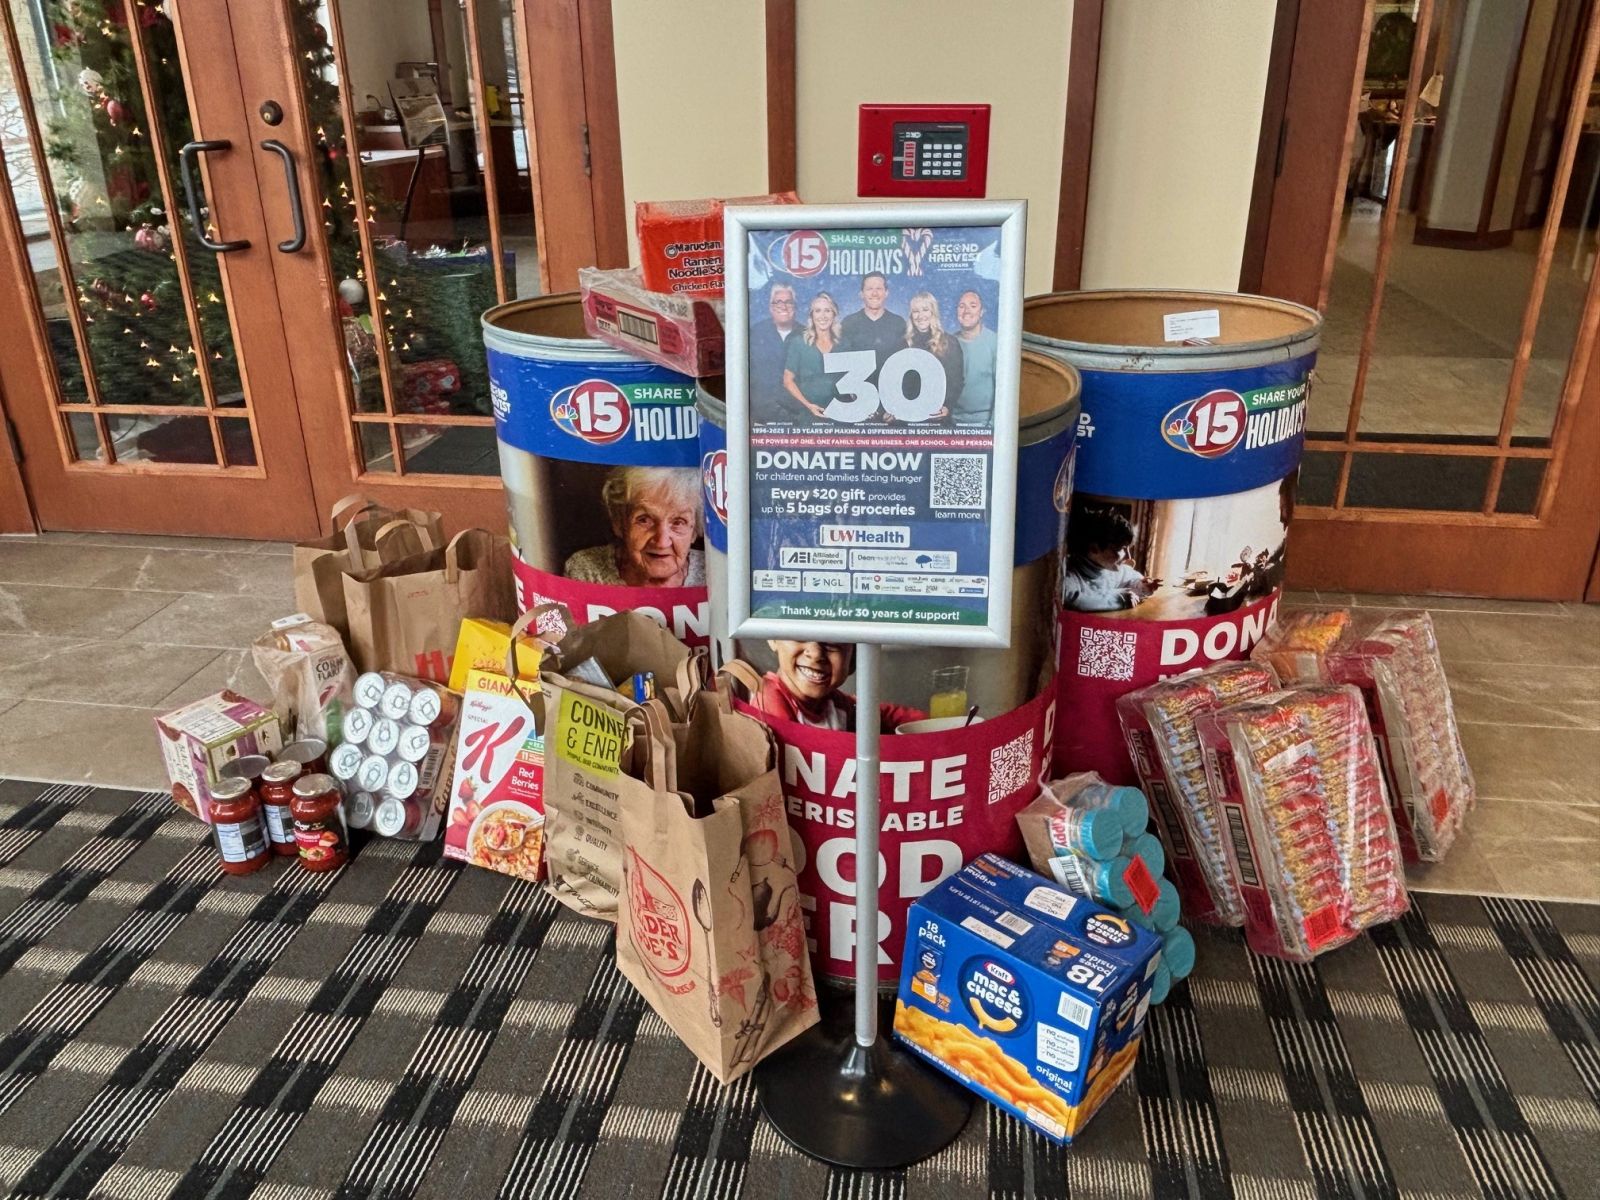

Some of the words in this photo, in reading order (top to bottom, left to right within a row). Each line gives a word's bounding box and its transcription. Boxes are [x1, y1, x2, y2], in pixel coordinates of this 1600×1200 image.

[676, 241, 721, 252] Maruchan
[831, 234, 864, 244] SHARE
[867, 235, 898, 245] YOUR
[932, 244, 979, 254] SECOND
[684, 256, 721, 267] Ramen
[788, 237, 822, 269] 15
[830, 248, 903, 276] HOLIDAYS
[928, 253, 980, 263] HARVEST
[668, 266, 709, 278] Noodle
[672, 282, 708, 292] Chicken
[634, 388, 682, 400] SHARE
[823, 348, 947, 423] 30
[1252, 390, 1286, 405] SHARE
[1287, 382, 1306, 400] YOUR
[576, 391, 623, 432] 15
[634, 406, 699, 442] HOLID
[1194, 402, 1240, 446] 15
[756, 451, 855, 470] DONATE
[861, 452, 923, 470] NOW
[756, 472, 767, 480] for
[770, 472, 804, 481] children
[807, 473, 824, 481] and
[826, 473, 858, 482] families
[861, 474, 889, 484] facing
[890, 474, 922, 484] hunger
[771, 488, 809, 501] Every
[812, 488, 837, 500] $20
[841, 489, 866, 502] gift
[868, 493, 906, 502] provides
[776, 505, 784, 513] to
[786, 502, 795, 513] 5
[798, 502, 831, 516] bags
[834, 502, 848, 514] of
[851, 504, 915, 517] groceries
[935, 510, 957, 519] learn
[788, 552, 810, 564] AEI
[780, 606, 811, 615] Thank
[814, 608, 836, 618] you,
[838, 608, 853, 616] for
[855, 608, 869, 617] 30
[872, 610, 899, 619] years
[901, 610, 913, 619] of
[915, 611, 960, 621] support!
[1160, 600, 1278, 666] DONA
[462, 716, 526, 784] K
[567, 727, 578, 749] &
[583, 732, 618, 762] ENR
[519, 767, 534, 779] Red
[784, 744, 968, 803] NATE
[512, 776, 539, 790] Berries
[586, 780, 619, 801] COMMUNITY
[585, 799, 618, 822] EXCELLENCE
[788, 795, 964, 832] ERISABLE
[586, 833, 608, 851] QUALITY
[788, 827, 964, 898] OD
[588, 873, 620, 898] TAINABILITY
[964, 866, 997, 886] original
[926, 920, 938, 934] 18
[1095, 928, 1122, 944] mac
[918, 926, 946, 948] pack
[1079, 958, 1113, 977] boxes
[1084, 952, 1117, 972] inside
[990, 965, 1009, 980] Kraft
[1066, 964, 1105, 992] 18
[974, 971, 1008, 998] mac
[1008, 990, 1020, 1006] &
[1046, 1040, 1056, 1048] no
[1036, 1065, 1072, 1090] original
